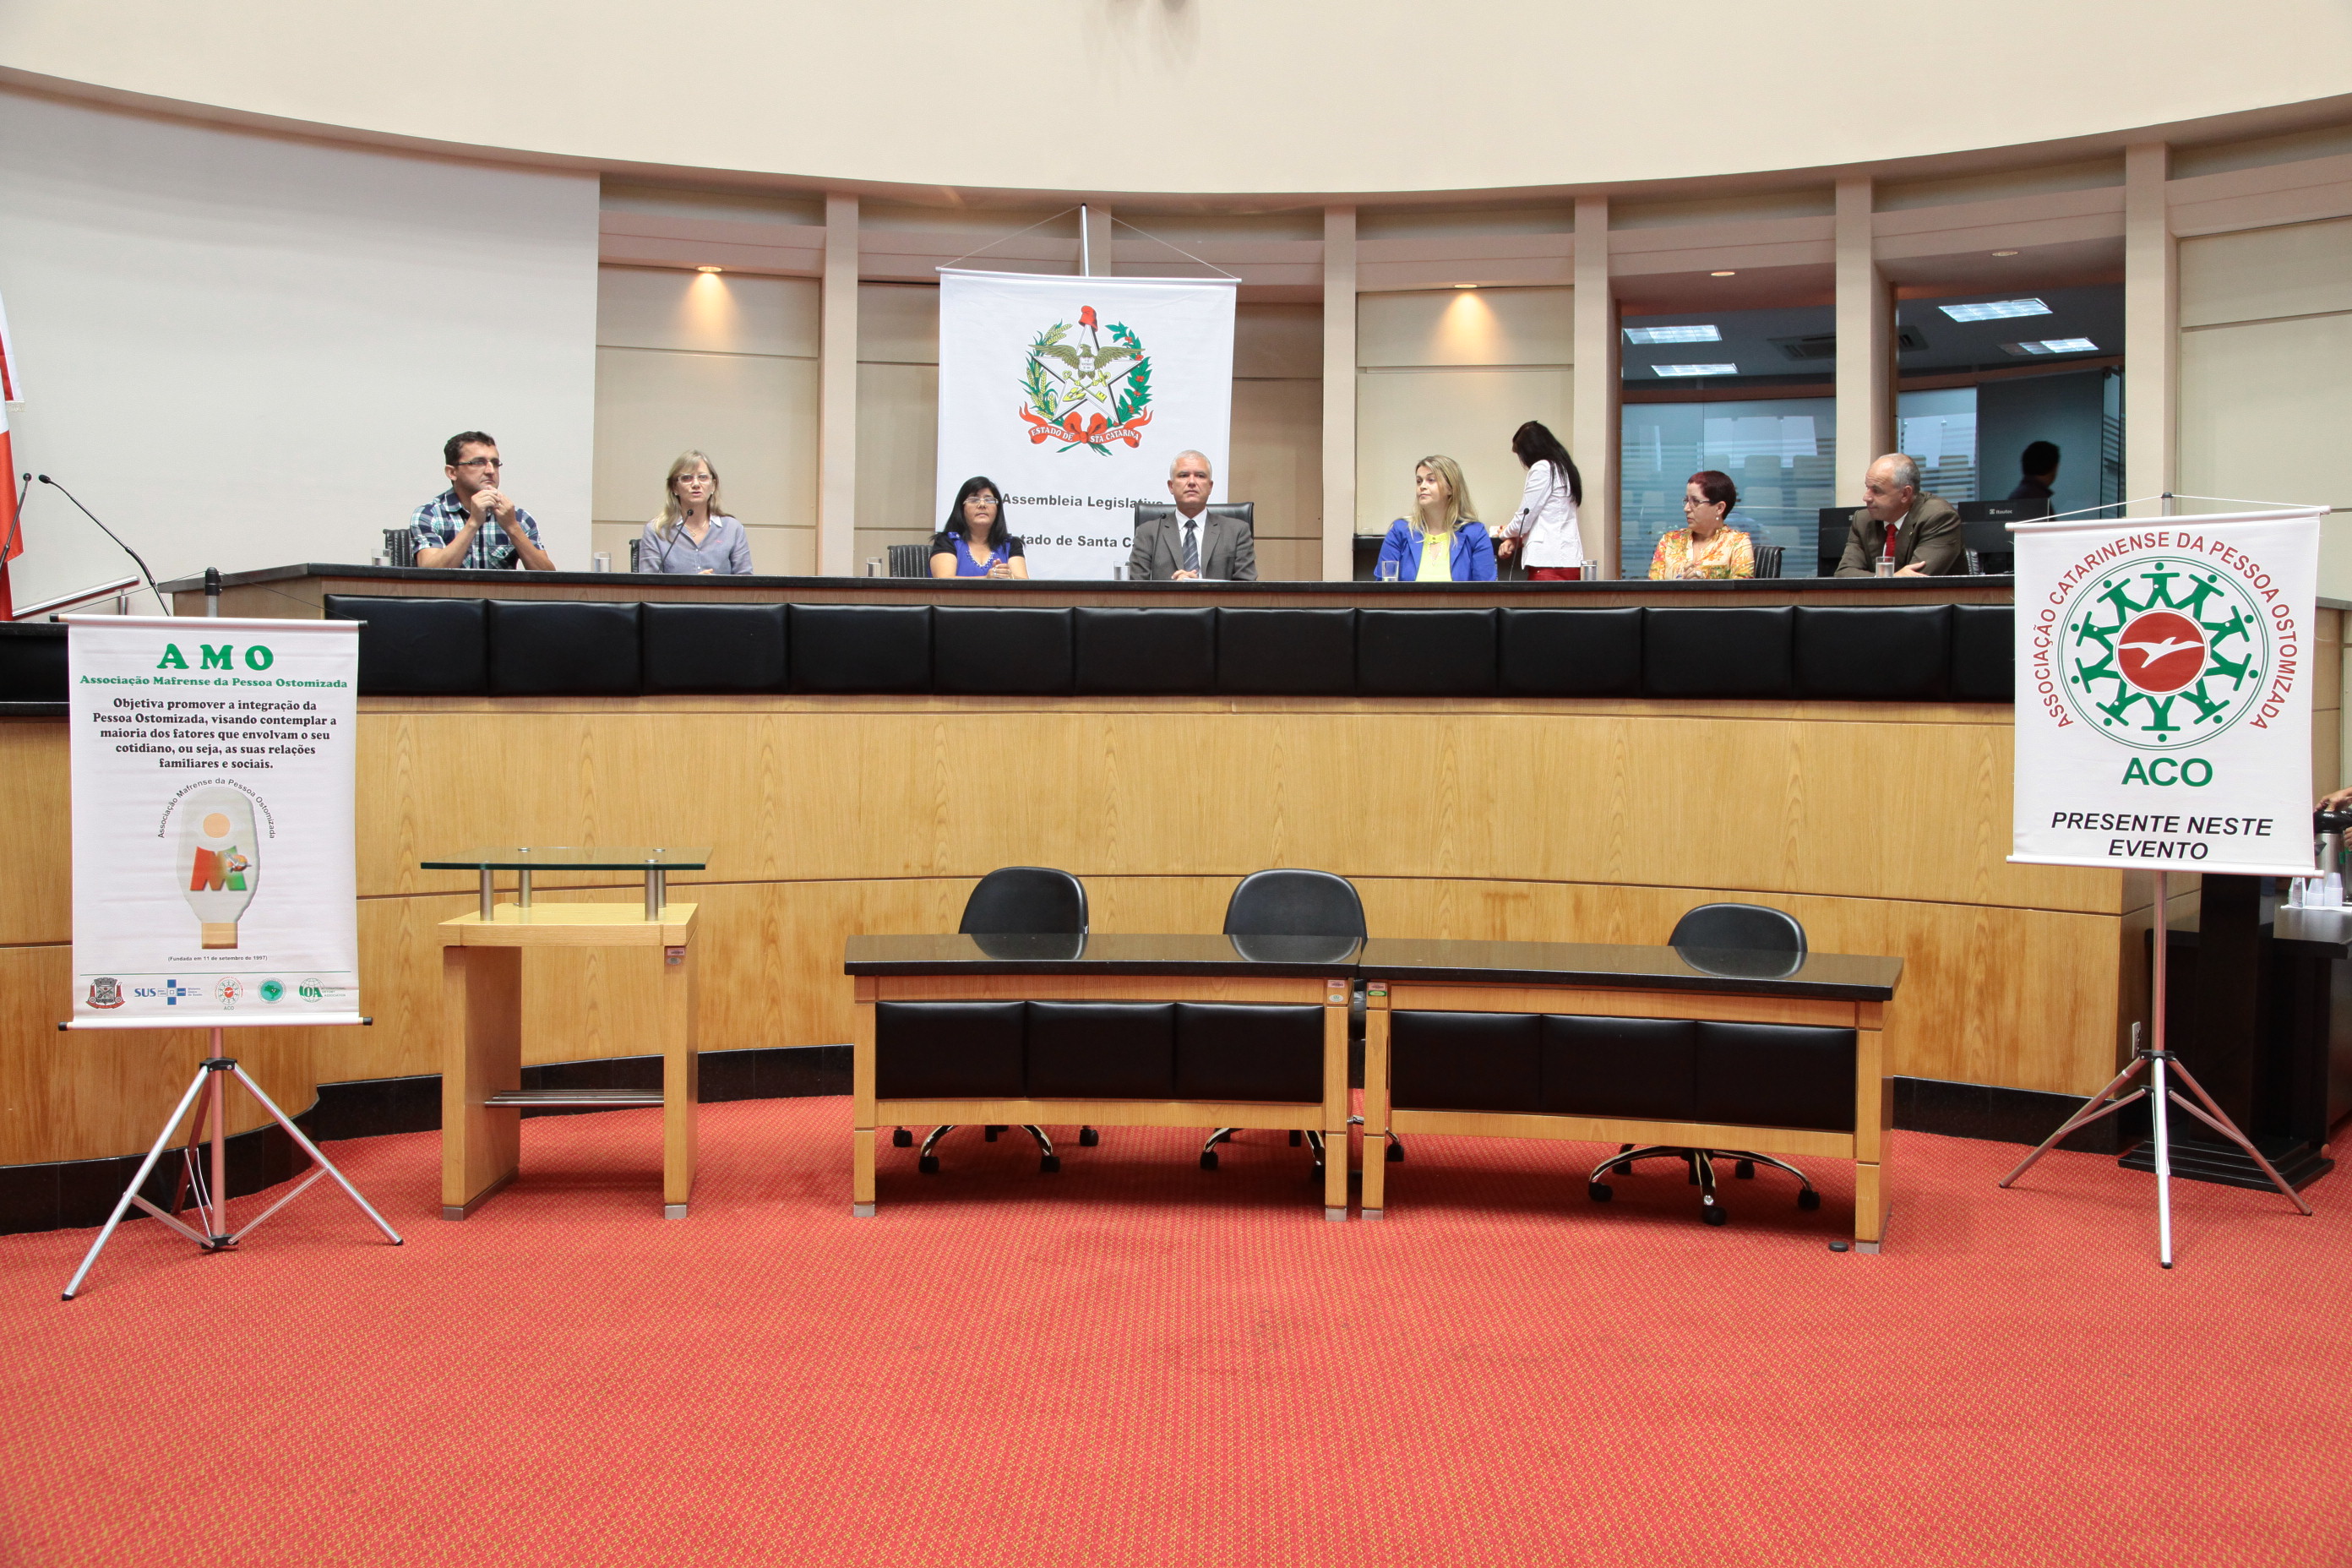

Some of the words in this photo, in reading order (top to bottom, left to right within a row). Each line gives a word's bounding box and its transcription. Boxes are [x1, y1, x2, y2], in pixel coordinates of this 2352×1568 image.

[1031, 427, 1062, 436] ESTADO
[1063, 432, 1075, 441] DE
[1105, 428, 1139, 440] CATARINA
[1002, 493, 1082, 507] Assembleia
[1087, 496, 1162, 510] Legisla
[1010, 534, 1052, 546] tado
[1056, 535, 1073, 546] de
[1077, 535, 1118, 547] Santa
[2176, 531, 2203, 553] DA
[2049, 531, 2170, 605] CATARINENSE
[2208, 540, 2280, 603] PESSOA
[2033, 608, 2074, 728] ASSOCIAÇÃO
[2249, 603, 2298, 729] OSTOMIZADA
[79, 675, 150, 686] Associação
[153, 677, 210, 686] Mafrense
[214, 678, 229, 686] da
[232, 678, 273, 687] Pessoa
[275, 678, 348, 688] Ostomizada
[113, 698, 164, 710] Objetiva
[167, 700, 226, 710] promover
[237, 700, 300, 711] integração
[302, 701, 317, 710] da
[93, 712, 132, 723] Pessoa
[135, 713, 209, 726] Ostomizada,
[211, 715, 257, 724] visando
[259, 716, 327, 727] contemplar
[101, 728, 147, 738] maioria
[150, 728, 170, 738] dos
[173, 728, 215, 738] fatores
[218, 731, 239, 741] que
[242, 730, 298, 739] envolvam
[301, 732, 308, 740] o
[311, 732, 330, 740] seu
[116, 743, 176, 754] cotidiano,
[196, 744, 222, 755] seja,
[240, 746, 266, 754] suas
[268, 744, 316, 756] relações
[159, 759, 220, 768] familiares
[231, 760, 274, 769] sociais.
[2121, 757, 2213, 787] ACO
[157, 798, 178, 838] Associação
[176, 778, 213, 798] Mafrense
[228, 778, 256, 798] Pessoa
[255, 796, 276, 839] Ostomizada
[2051, 812, 2180, 833] PRESENTE
[2186, 816, 2273, 836] NESTE
[2108, 839, 2208, 860] EVENTO
[134, 988, 156, 997] SUS
